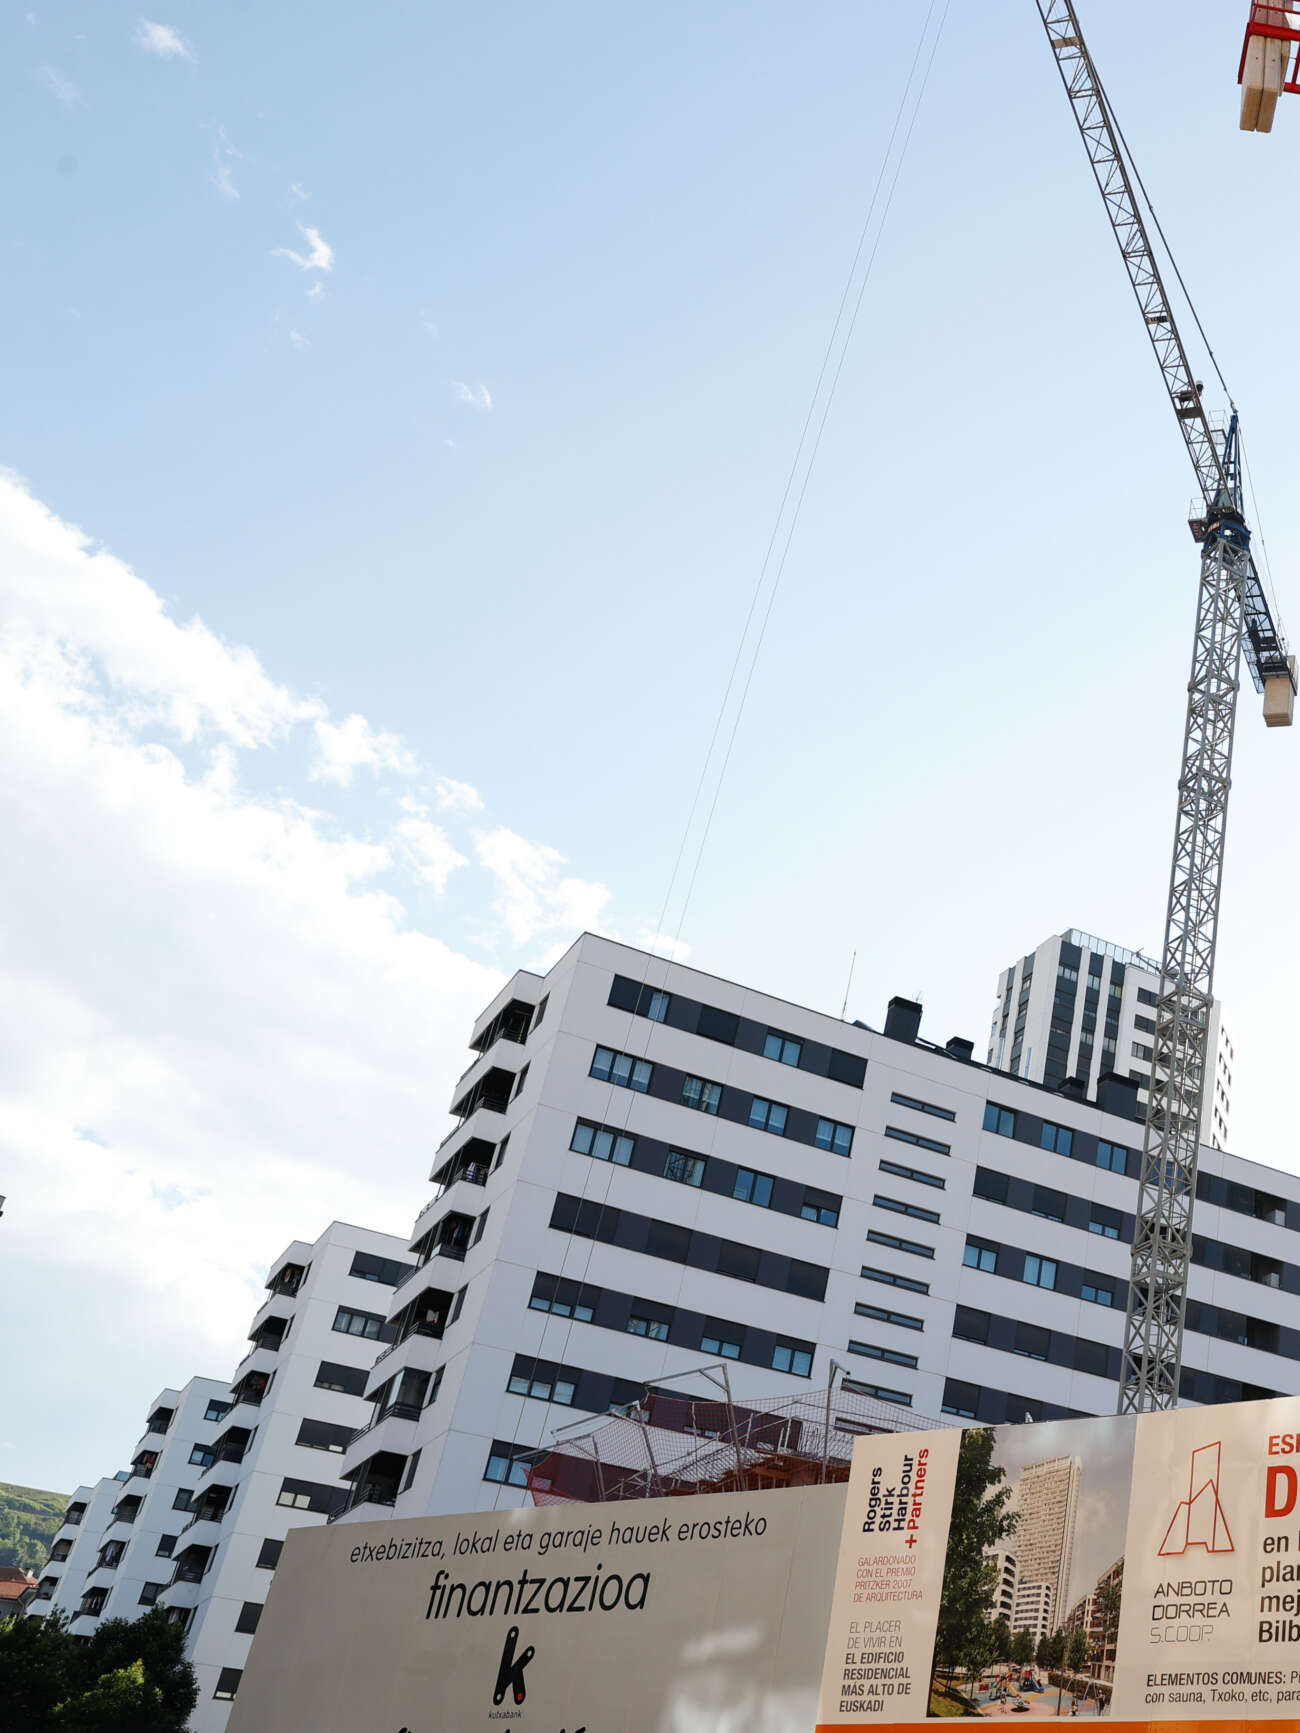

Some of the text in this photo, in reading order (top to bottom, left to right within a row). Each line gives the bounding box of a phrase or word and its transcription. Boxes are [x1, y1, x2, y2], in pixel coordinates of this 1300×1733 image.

[892, 1455, 914, 1531] Harbour
[907, 1449, 929, 1530] Partners
[863, 1466, 882, 1532] Rogers
[879, 1487, 896, 1532] Stirk
[350, 1512, 767, 1564] etxebizitza, lokal eta garaje hauek erosteko
[1263, 1534, 1289, 1554] en
[858, 1554, 916, 1566] GALARDONADO
[856, 1566, 916, 1579] CON EL PREMIO
[425, 1562, 651, 1620] finantzazioa
[855, 1578, 912, 1590] PRITZKER 2007
[1154, 1579, 1233, 1599] ANBOTO
[853, 1590, 923, 1603] DE ARQUITECTURA
[1152, 1602, 1230, 1621] DORREA
[850, 1620, 902, 1634] EL PLACER
[848, 1636, 903, 1649] DE VIVIR EN
[846, 1652, 904, 1664] EL EDIFICIO
[843, 1666, 910, 1680] RESIDENCIAL
[1146, 1672, 1218, 1687] ELEMENTOS
[1222, 1671, 1286, 1686] COMUNES:
[841, 1681, 912, 1696] MÁS ALTO DE
[1145, 1692, 1167, 1704] con
[1168, 1692, 1206, 1704] sauna,
[1210, 1689, 1248, 1704] Txoko,
[1251, 1690, 1272, 1704] etc,
[839, 1700, 884, 1712] EUSKADI
